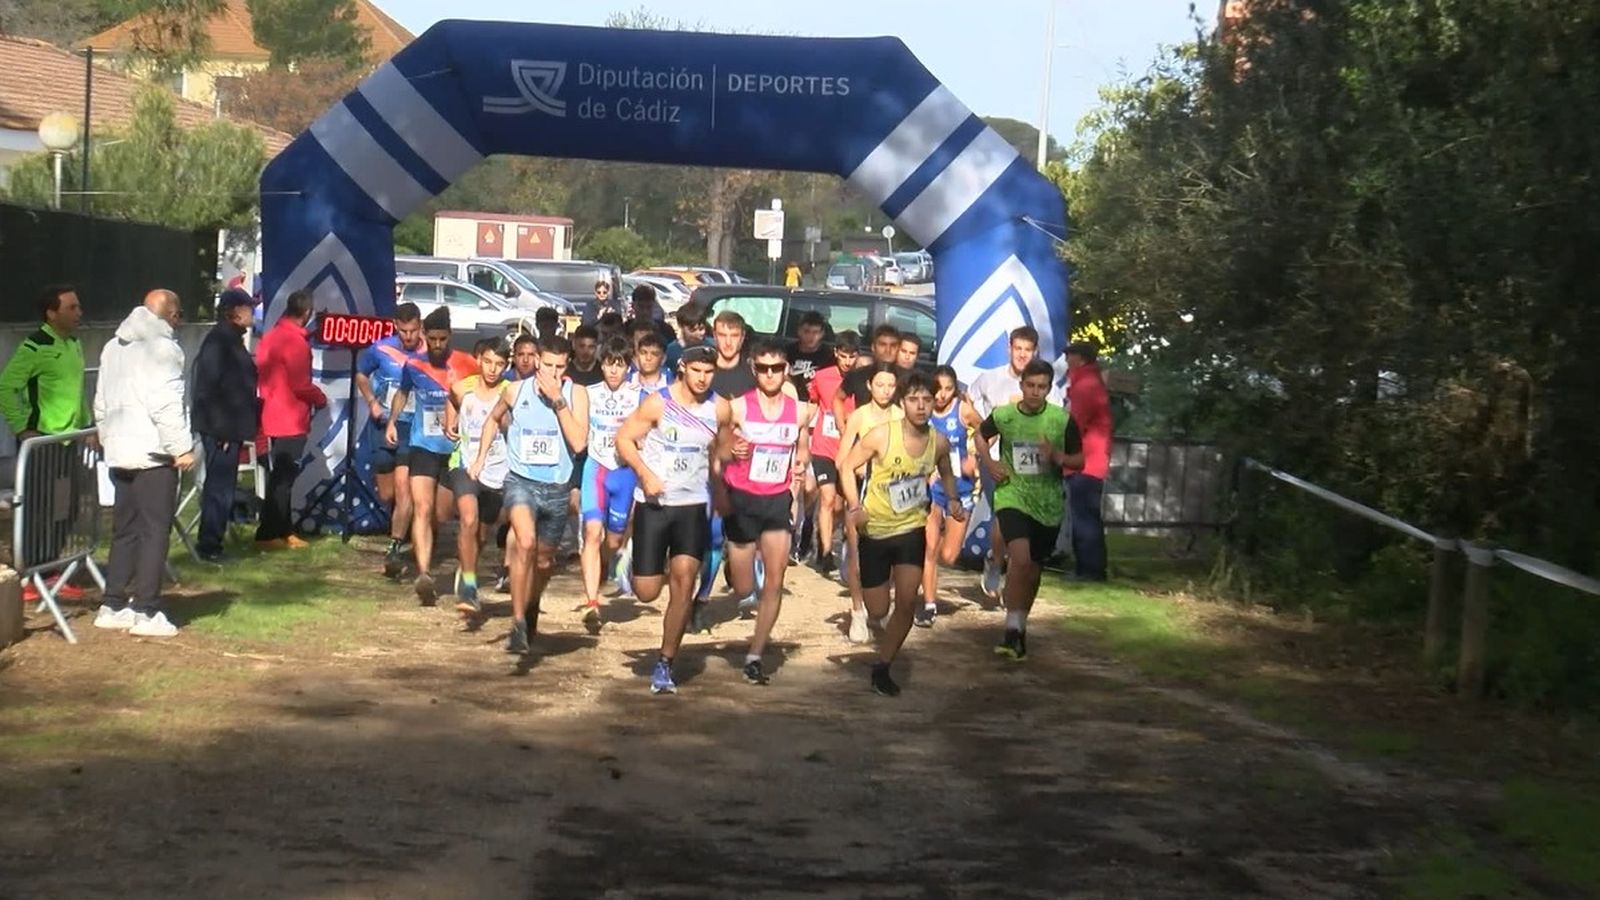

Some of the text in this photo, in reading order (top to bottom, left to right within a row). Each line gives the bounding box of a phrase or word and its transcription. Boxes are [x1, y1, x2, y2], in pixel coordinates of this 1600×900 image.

[578, 63, 703, 91] Diputación
[728, 73, 850, 96] DEPORTES
[578, 97, 681, 123] de Cádiz
[532, 441, 547, 455] 50
